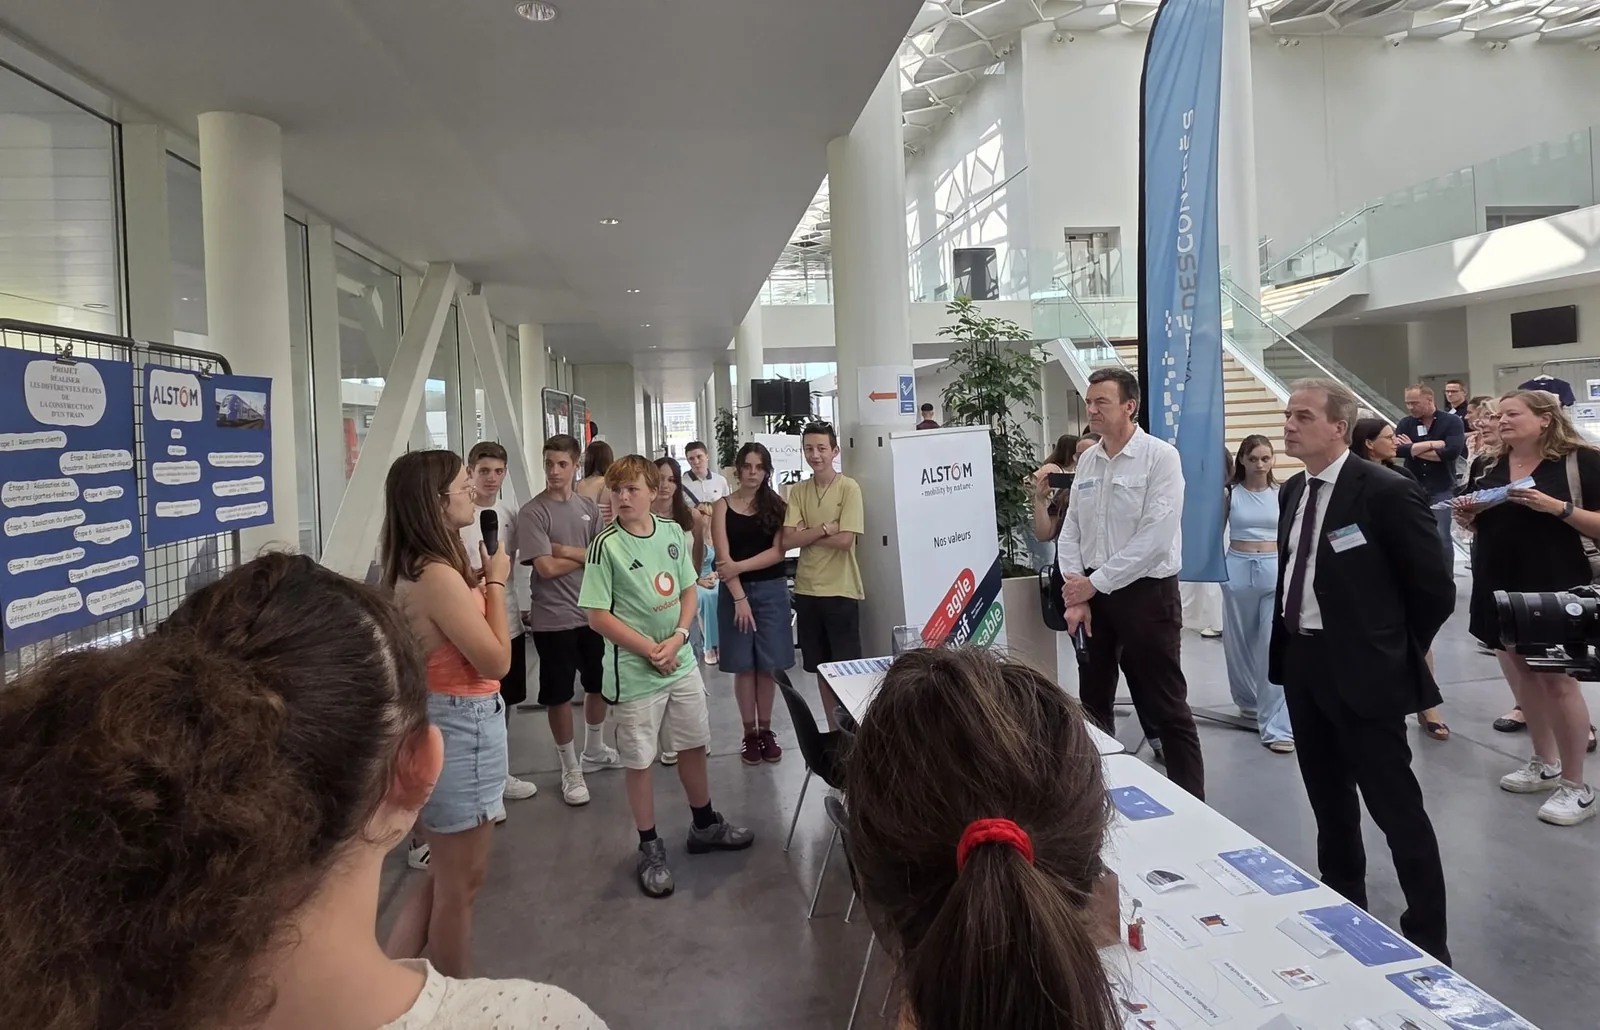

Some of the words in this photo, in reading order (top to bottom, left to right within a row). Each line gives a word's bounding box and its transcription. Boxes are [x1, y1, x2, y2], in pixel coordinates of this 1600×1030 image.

[52, 365, 79, 375] PROJET
[30, 381, 41, 389] LES
[153, 385, 198, 407] ALSTOM
[921, 462, 972, 485] ALSTOM
[933, 536, 947, 548] Nos
[947, 531, 972, 544] valeurs
[945, 578, 971, 619] agile
[950, 613, 971, 648] usif
[977, 608, 1003, 647] sable
